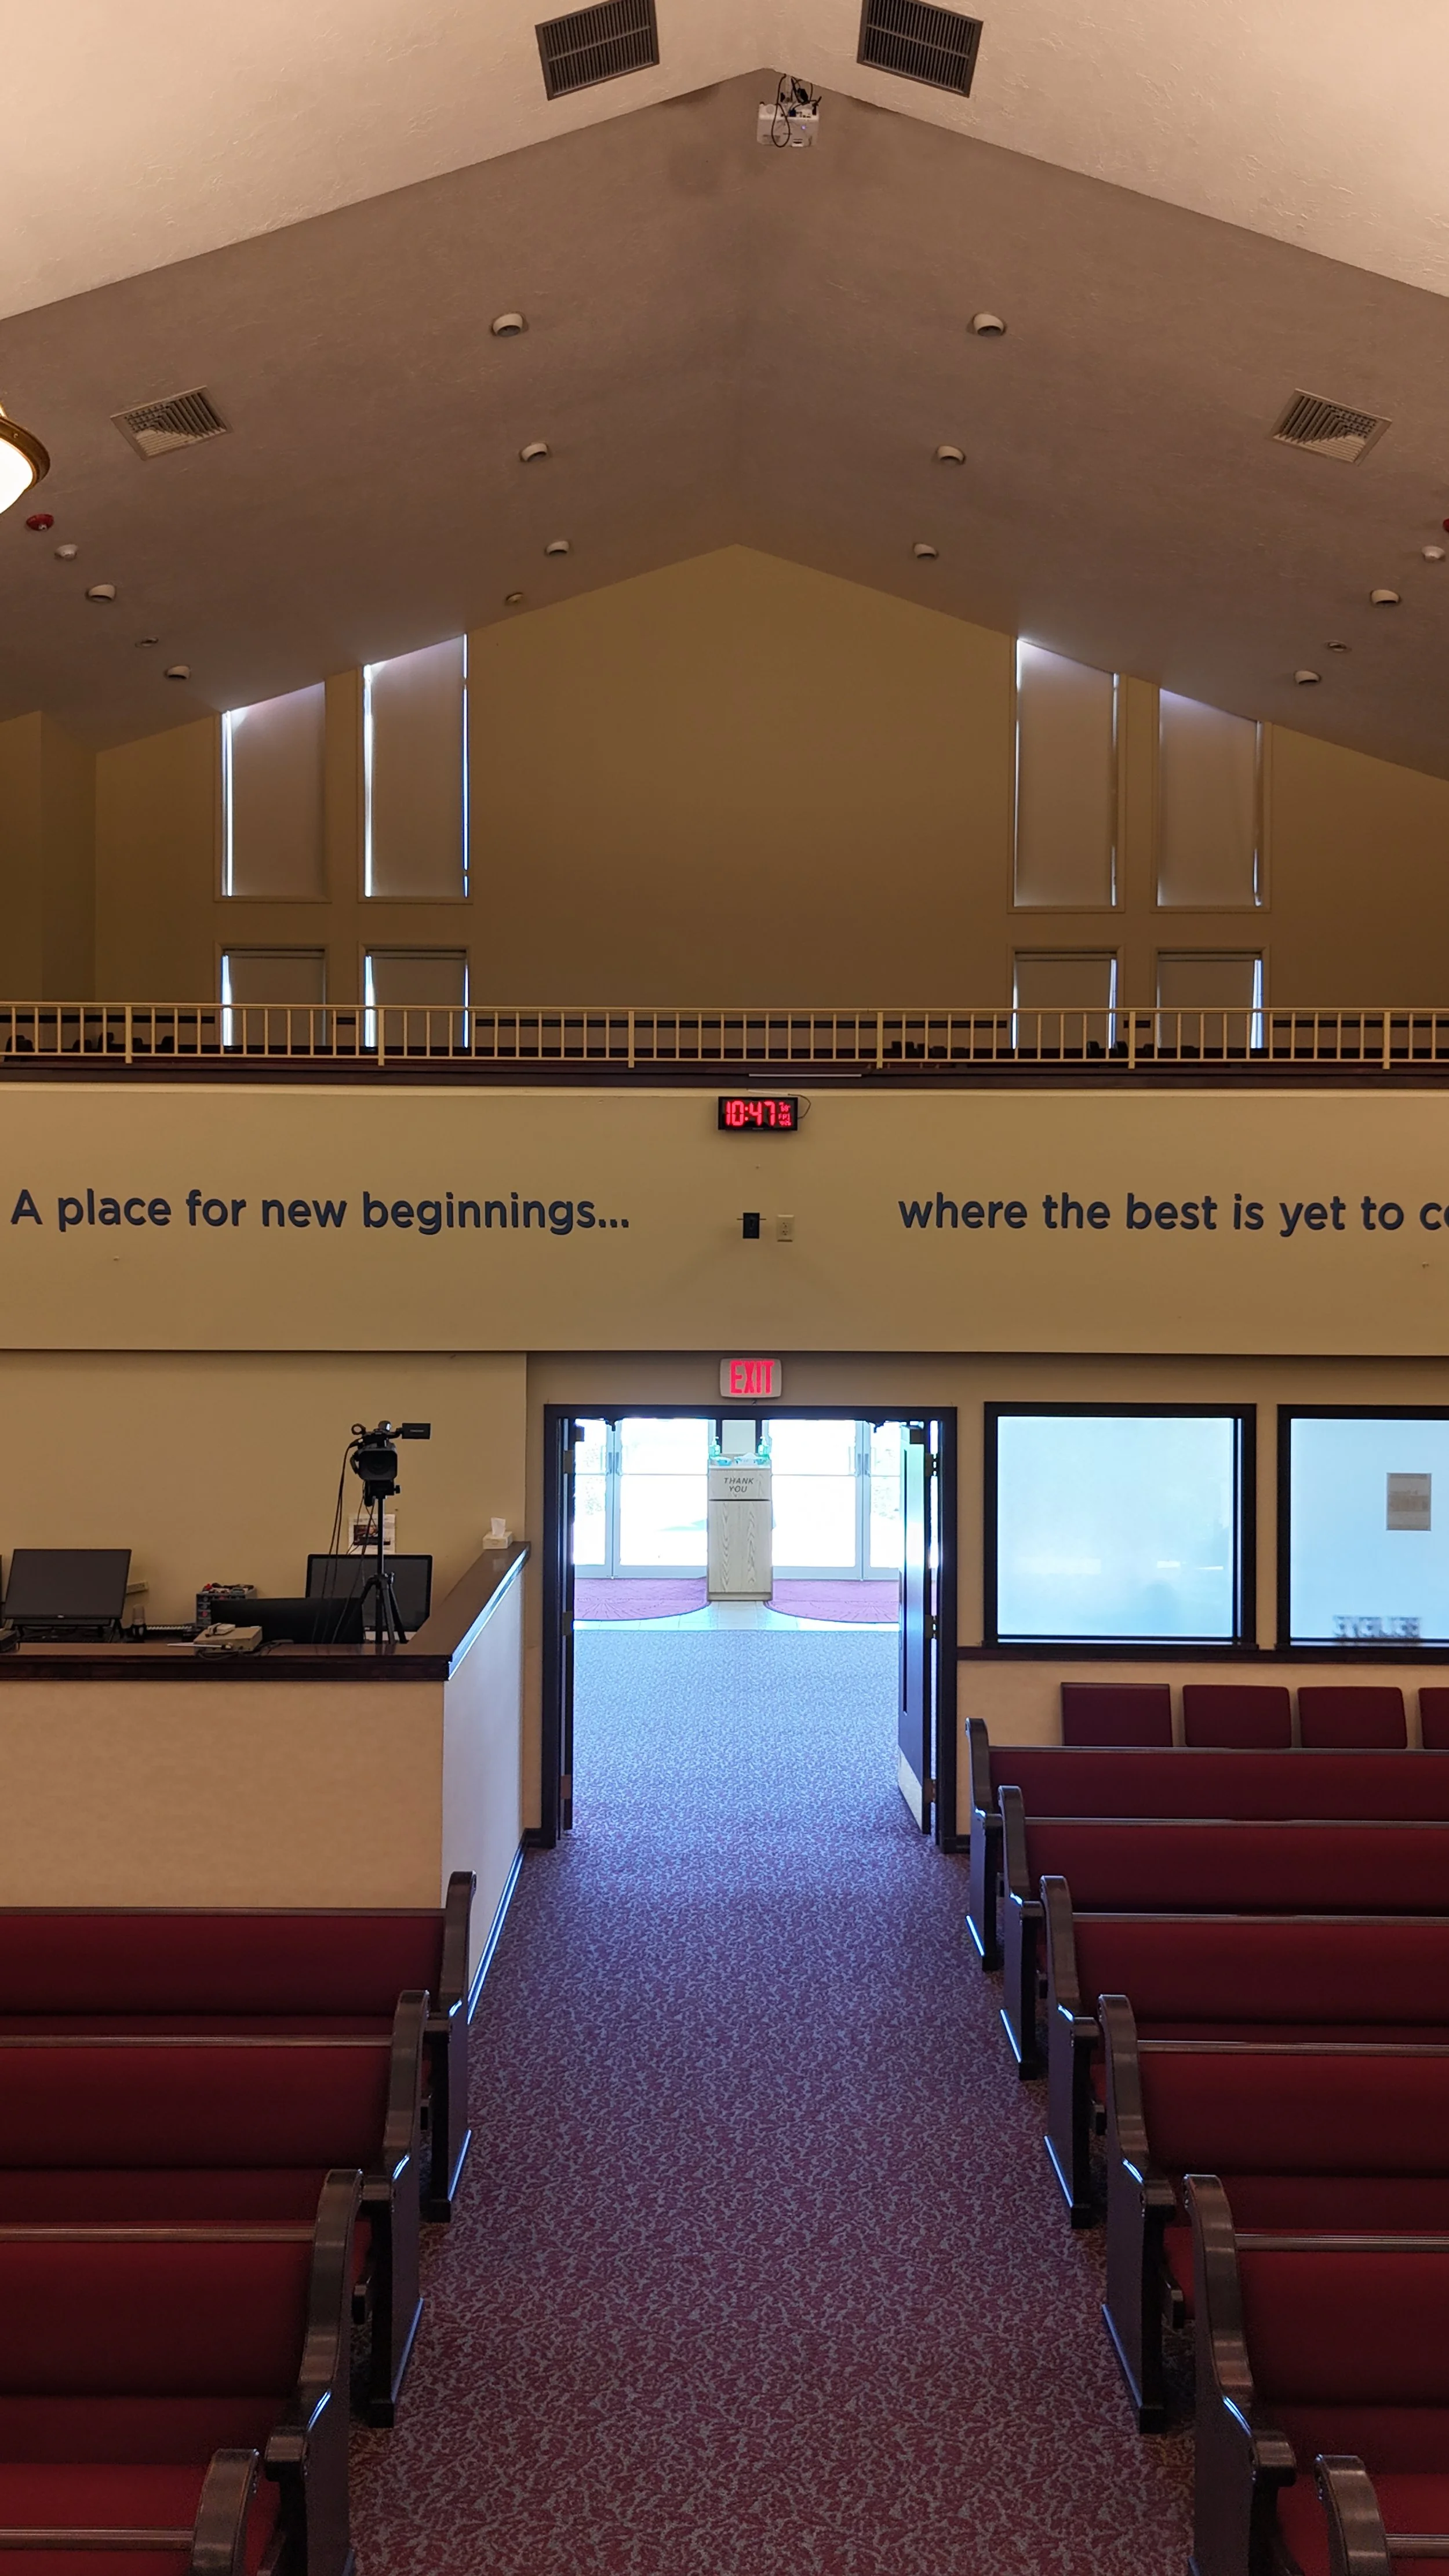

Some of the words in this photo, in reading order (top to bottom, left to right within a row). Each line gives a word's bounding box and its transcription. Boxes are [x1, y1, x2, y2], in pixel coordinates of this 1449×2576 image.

[726, 1100, 776, 1126] 10:47
[10, 1189, 43, 1225] A
[57, 1188, 172, 1233] place
[185, 1189, 247, 1227] for
[261, 1199, 348, 1228] new
[363, 1191, 629, 1236] beginnings...
[898, 1191, 1028, 1229] where
[1042, 1192, 1111, 1229] the
[1126, 1192, 1218, 1230] best
[1233, 1193, 1264, 1231] is
[1279, 1196, 1346, 1238] yet
[1360, 1196, 1404, 1231] to
[1419, 1202, 1449, 1231] c
[730, 1360, 775, 1394] EXIT
